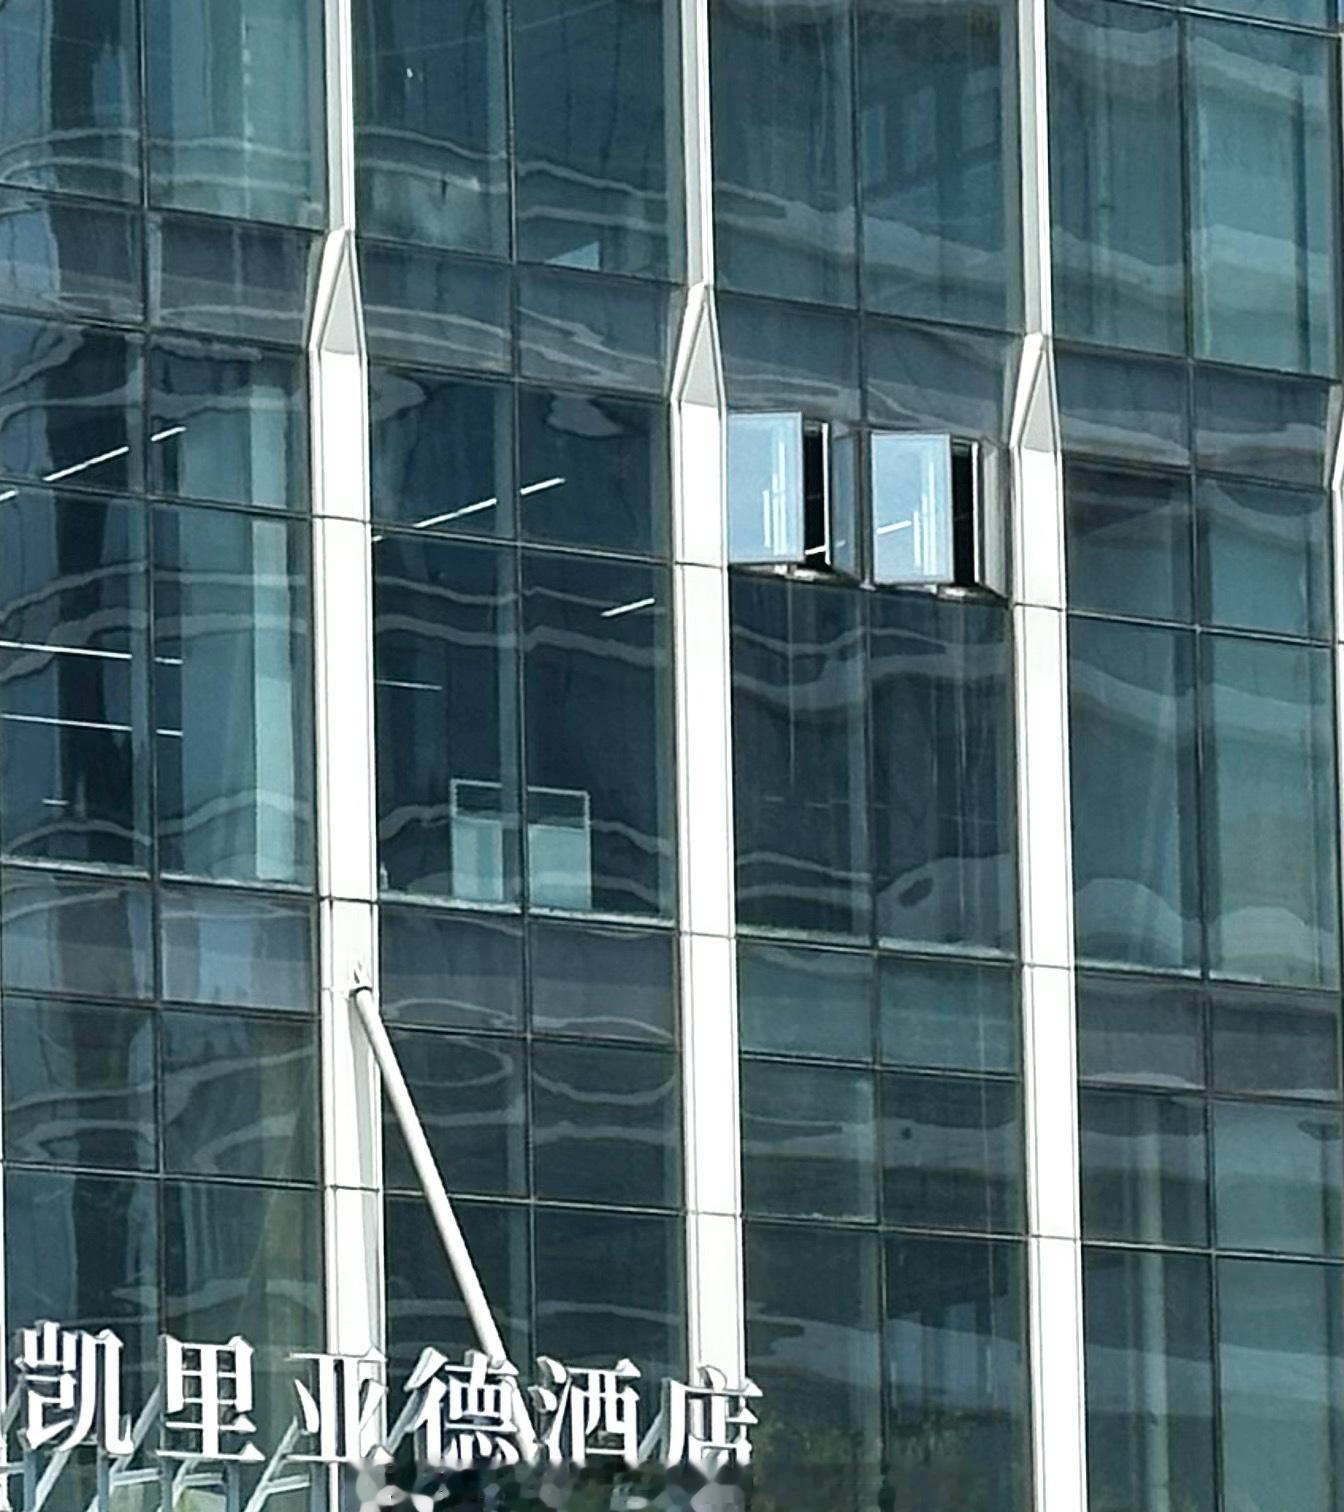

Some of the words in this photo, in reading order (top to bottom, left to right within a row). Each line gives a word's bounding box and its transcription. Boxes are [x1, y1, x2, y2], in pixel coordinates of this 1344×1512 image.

[14, 1321, 764, 1470] 凯里亚德酒店
